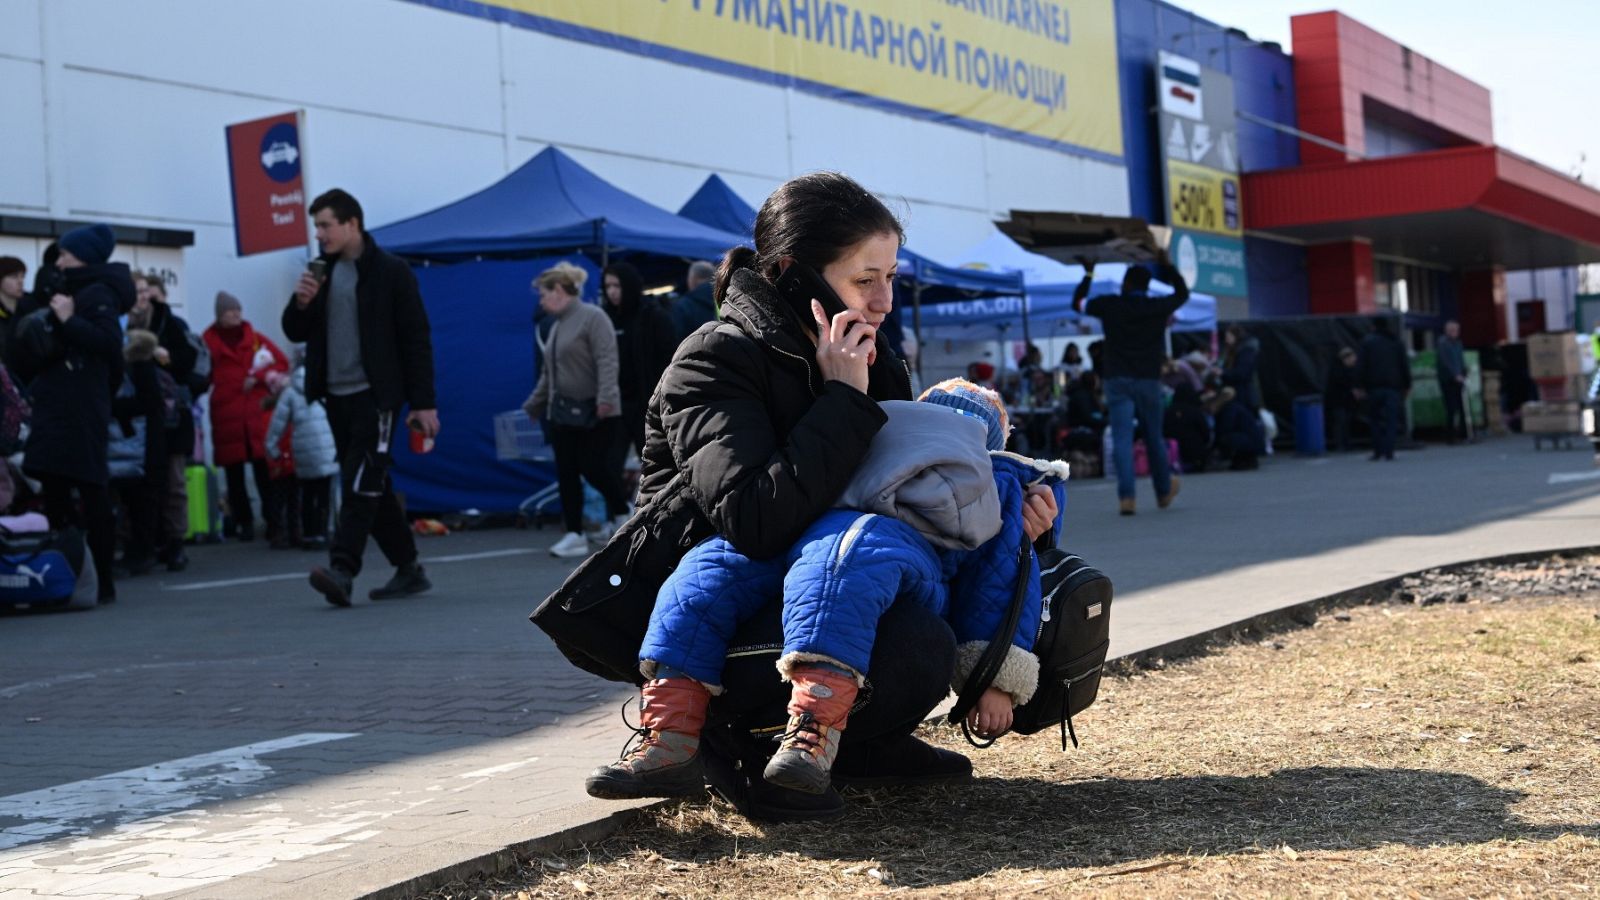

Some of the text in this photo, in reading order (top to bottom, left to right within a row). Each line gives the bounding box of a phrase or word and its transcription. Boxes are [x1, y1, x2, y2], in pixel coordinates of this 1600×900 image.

[692, 0, 1068, 115] МАНИТАРНОЙ ПОМОЩИ
[273, 211, 294, 225] Taxi
[1174, 182, 1215, 229] -50%
